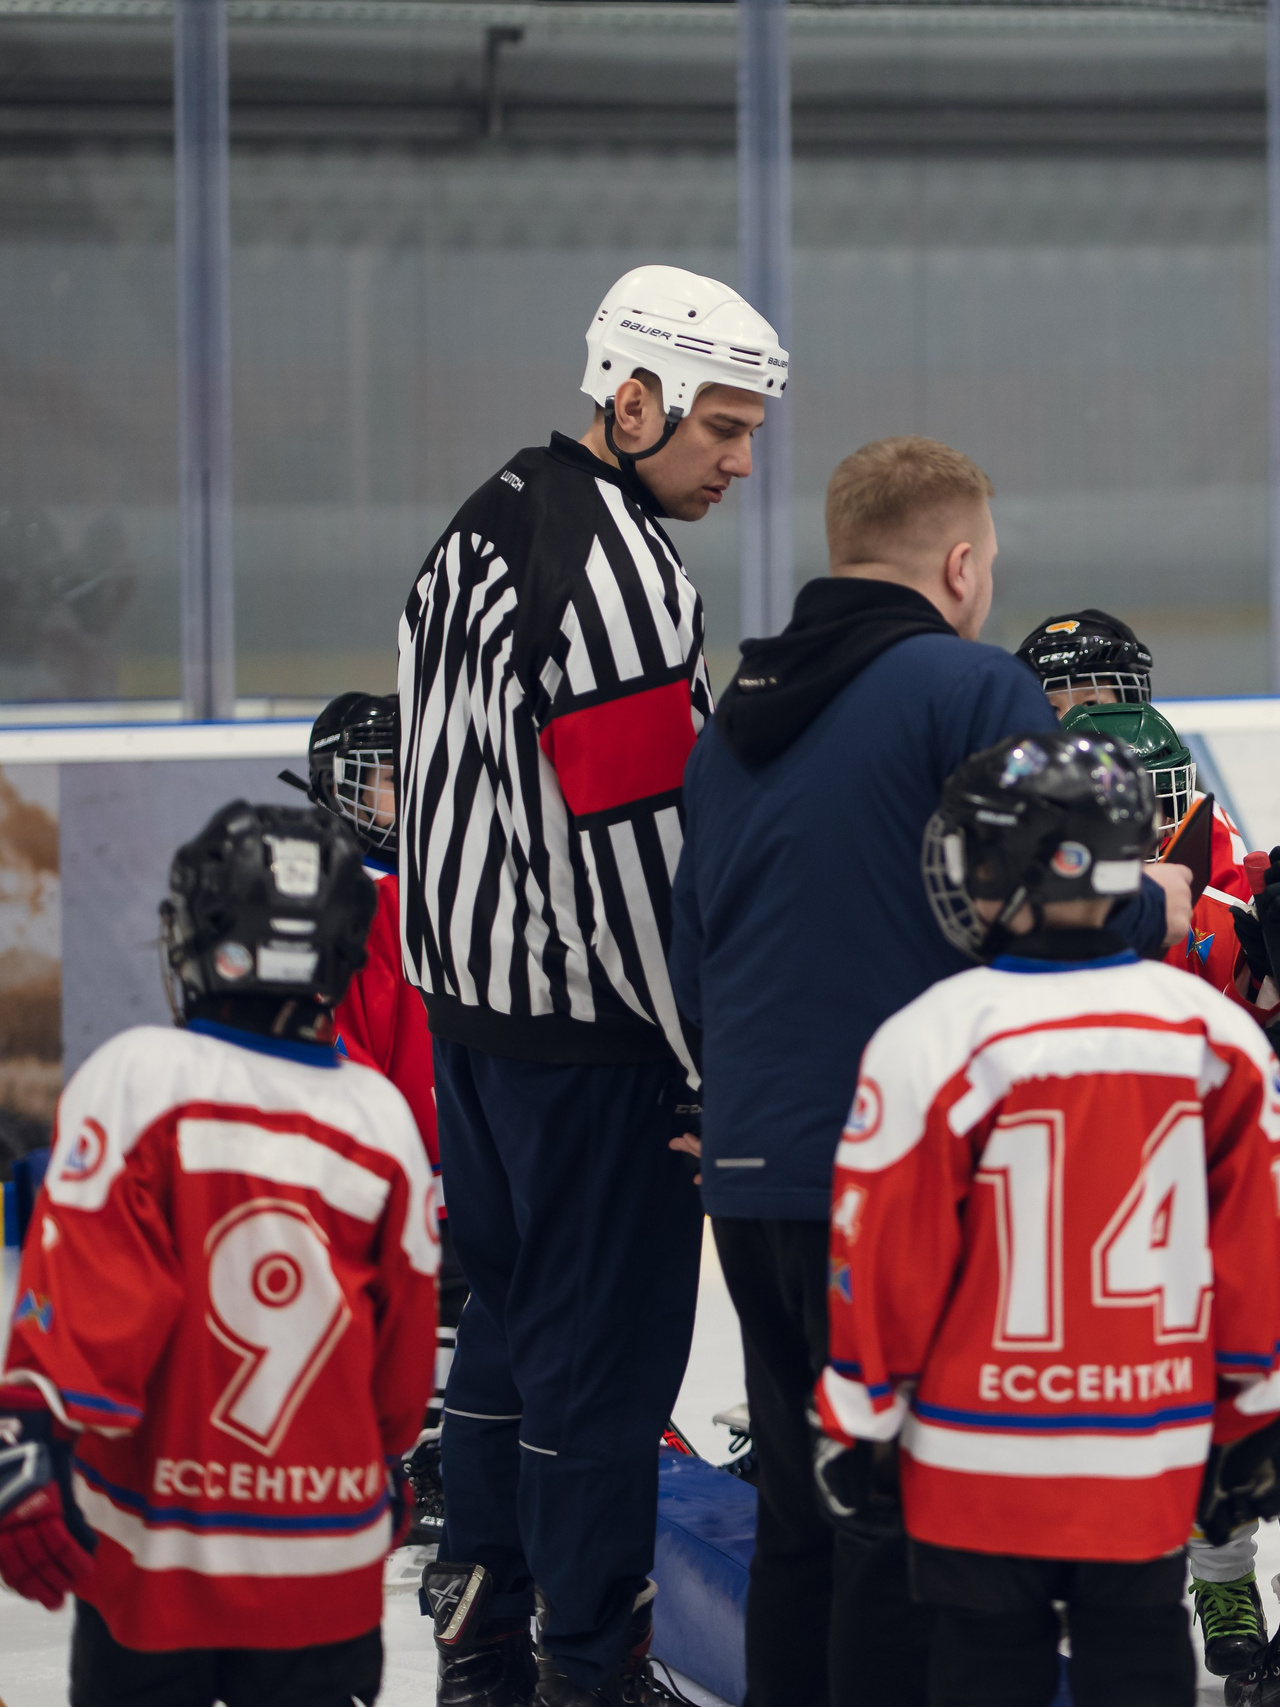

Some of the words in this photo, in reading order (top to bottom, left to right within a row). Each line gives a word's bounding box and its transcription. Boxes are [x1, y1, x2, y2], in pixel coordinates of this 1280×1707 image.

[620, 319, 673, 340] BAUER
[767, 357, 788, 368] BAUER
[500, 470, 525, 491] LUTCH
[1039, 651, 1076, 664] CCM
[975, 1101, 1214, 1351] 14
[204, 1197, 353, 1457] 9
[979, 1356, 1193, 1403] ЕССЕНТКИ
